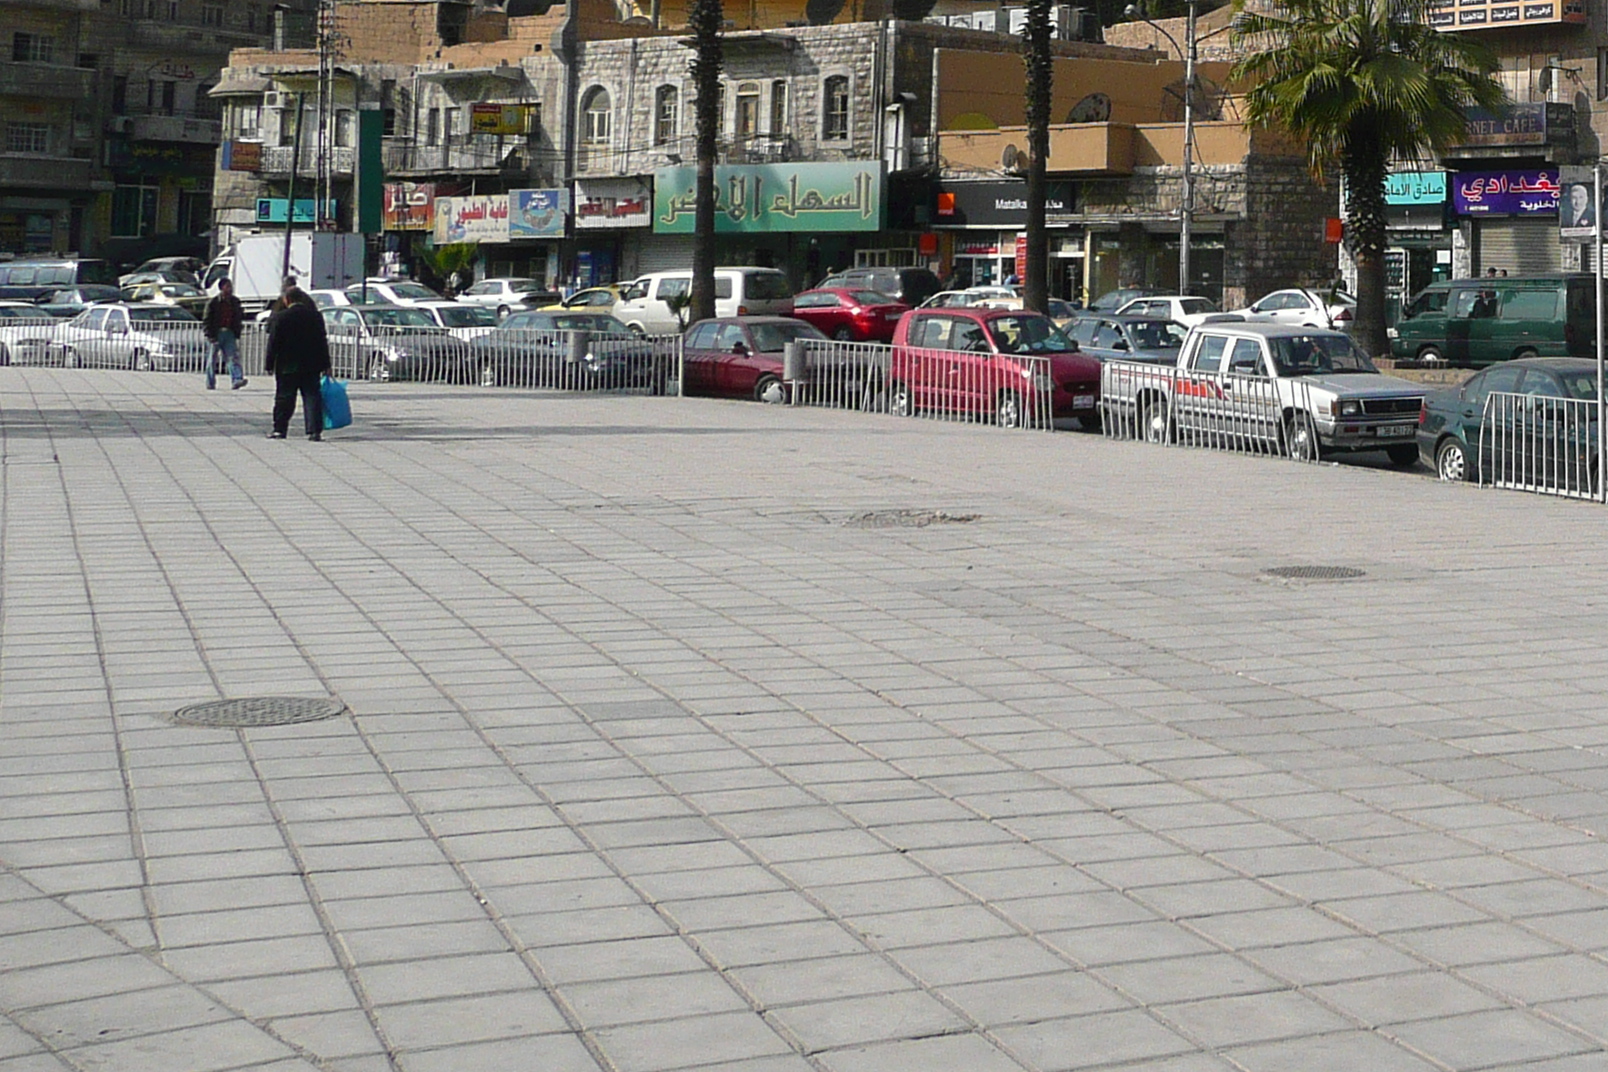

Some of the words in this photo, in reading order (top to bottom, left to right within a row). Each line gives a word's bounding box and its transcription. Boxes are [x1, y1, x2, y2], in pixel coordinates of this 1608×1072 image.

[1504, 118, 1537, 133] CAFE
[1412, 183, 1444, 201] صادق
[1461, 172, 1562, 203] بغدادي
